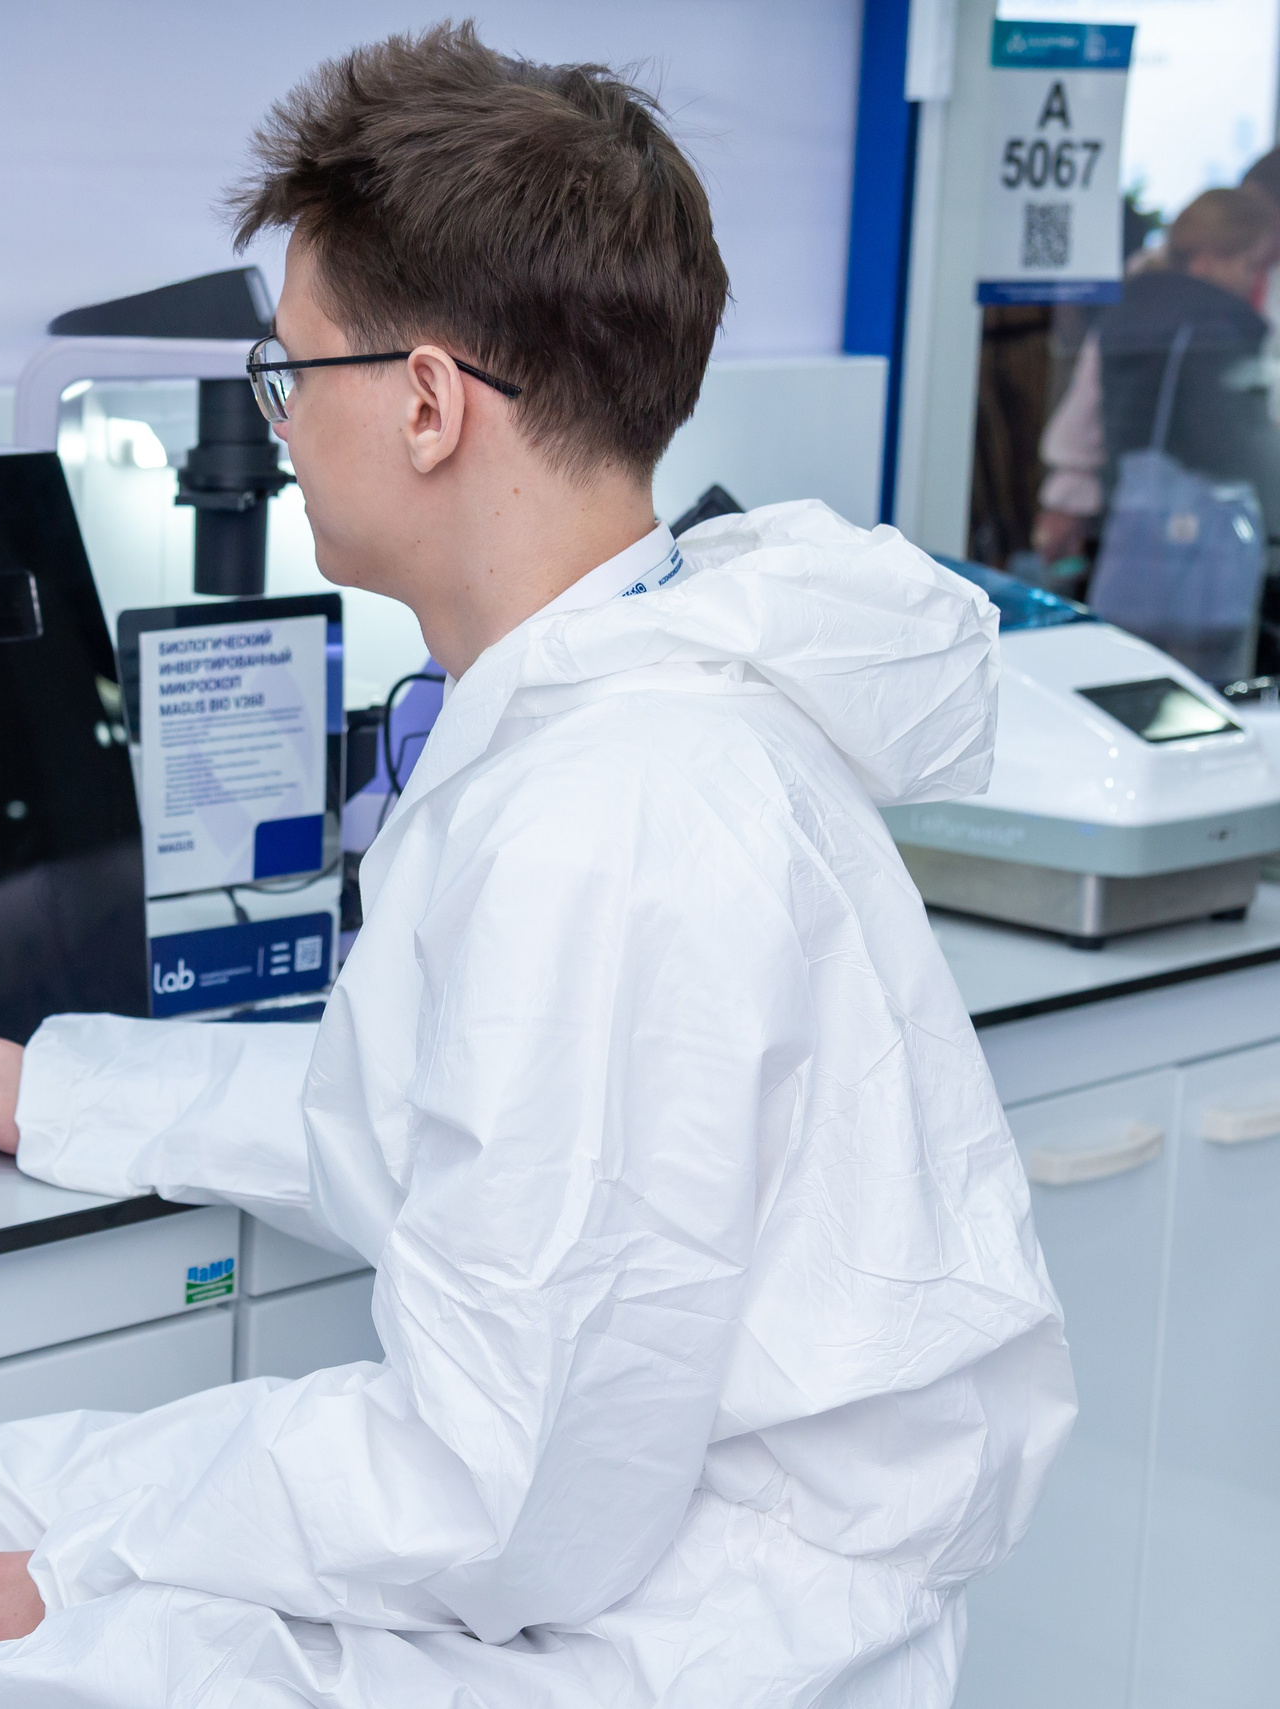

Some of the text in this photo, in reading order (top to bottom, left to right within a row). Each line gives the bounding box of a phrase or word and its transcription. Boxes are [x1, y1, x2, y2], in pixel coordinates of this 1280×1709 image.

[1002, 138, 1101, 188] 5067
[158, 628, 273, 656] БИОЛОГИЧЕСКИЙ
[158, 646, 293, 676] ИНВЕРТИРОВАННЫЙ
[159, 674, 243, 697] МИКРОСКОП
[159, 699, 206, 717] MAGUS
[208, 695, 231, 712] BIO
[153, 957, 196, 995] lab
